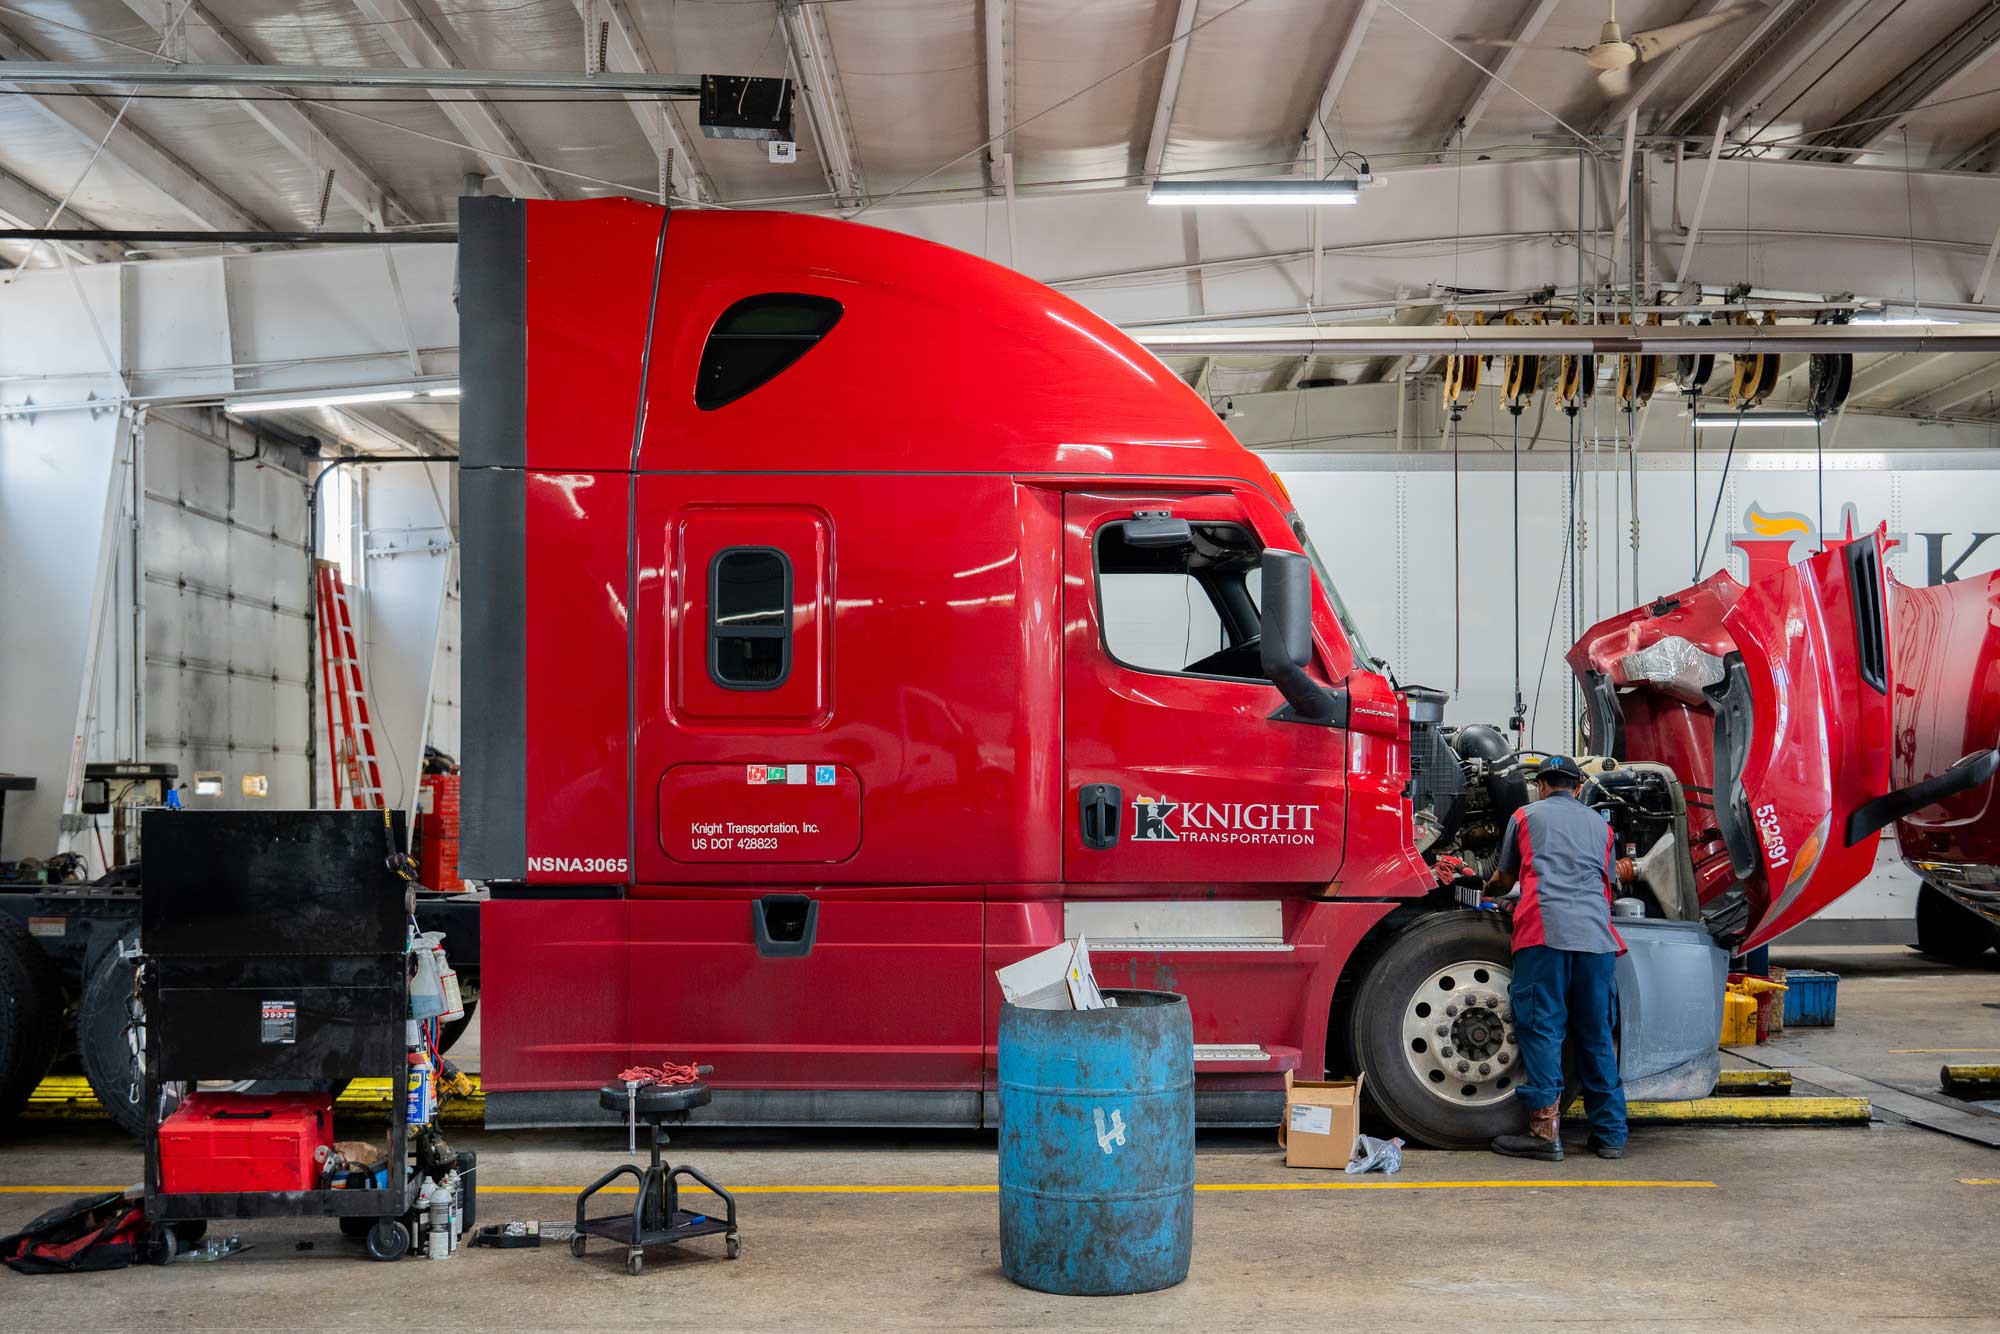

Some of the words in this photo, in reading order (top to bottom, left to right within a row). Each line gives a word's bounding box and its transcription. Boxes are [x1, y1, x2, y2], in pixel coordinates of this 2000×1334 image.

[1181, 802, 1320, 831] KNIGHT
[691, 822, 723, 836] Knight
[726, 822, 800, 836] Transportation,
[802, 822, 820, 833] Inc.
[1756, 804, 1790, 869] 532691
[691, 838, 708, 849] US
[710, 838, 734, 849] DOT
[737, 837, 778, 849] 428823
[1179, 831, 1315, 845] TRANSPORTATION
[527, 857, 628, 873] NSNA3065
